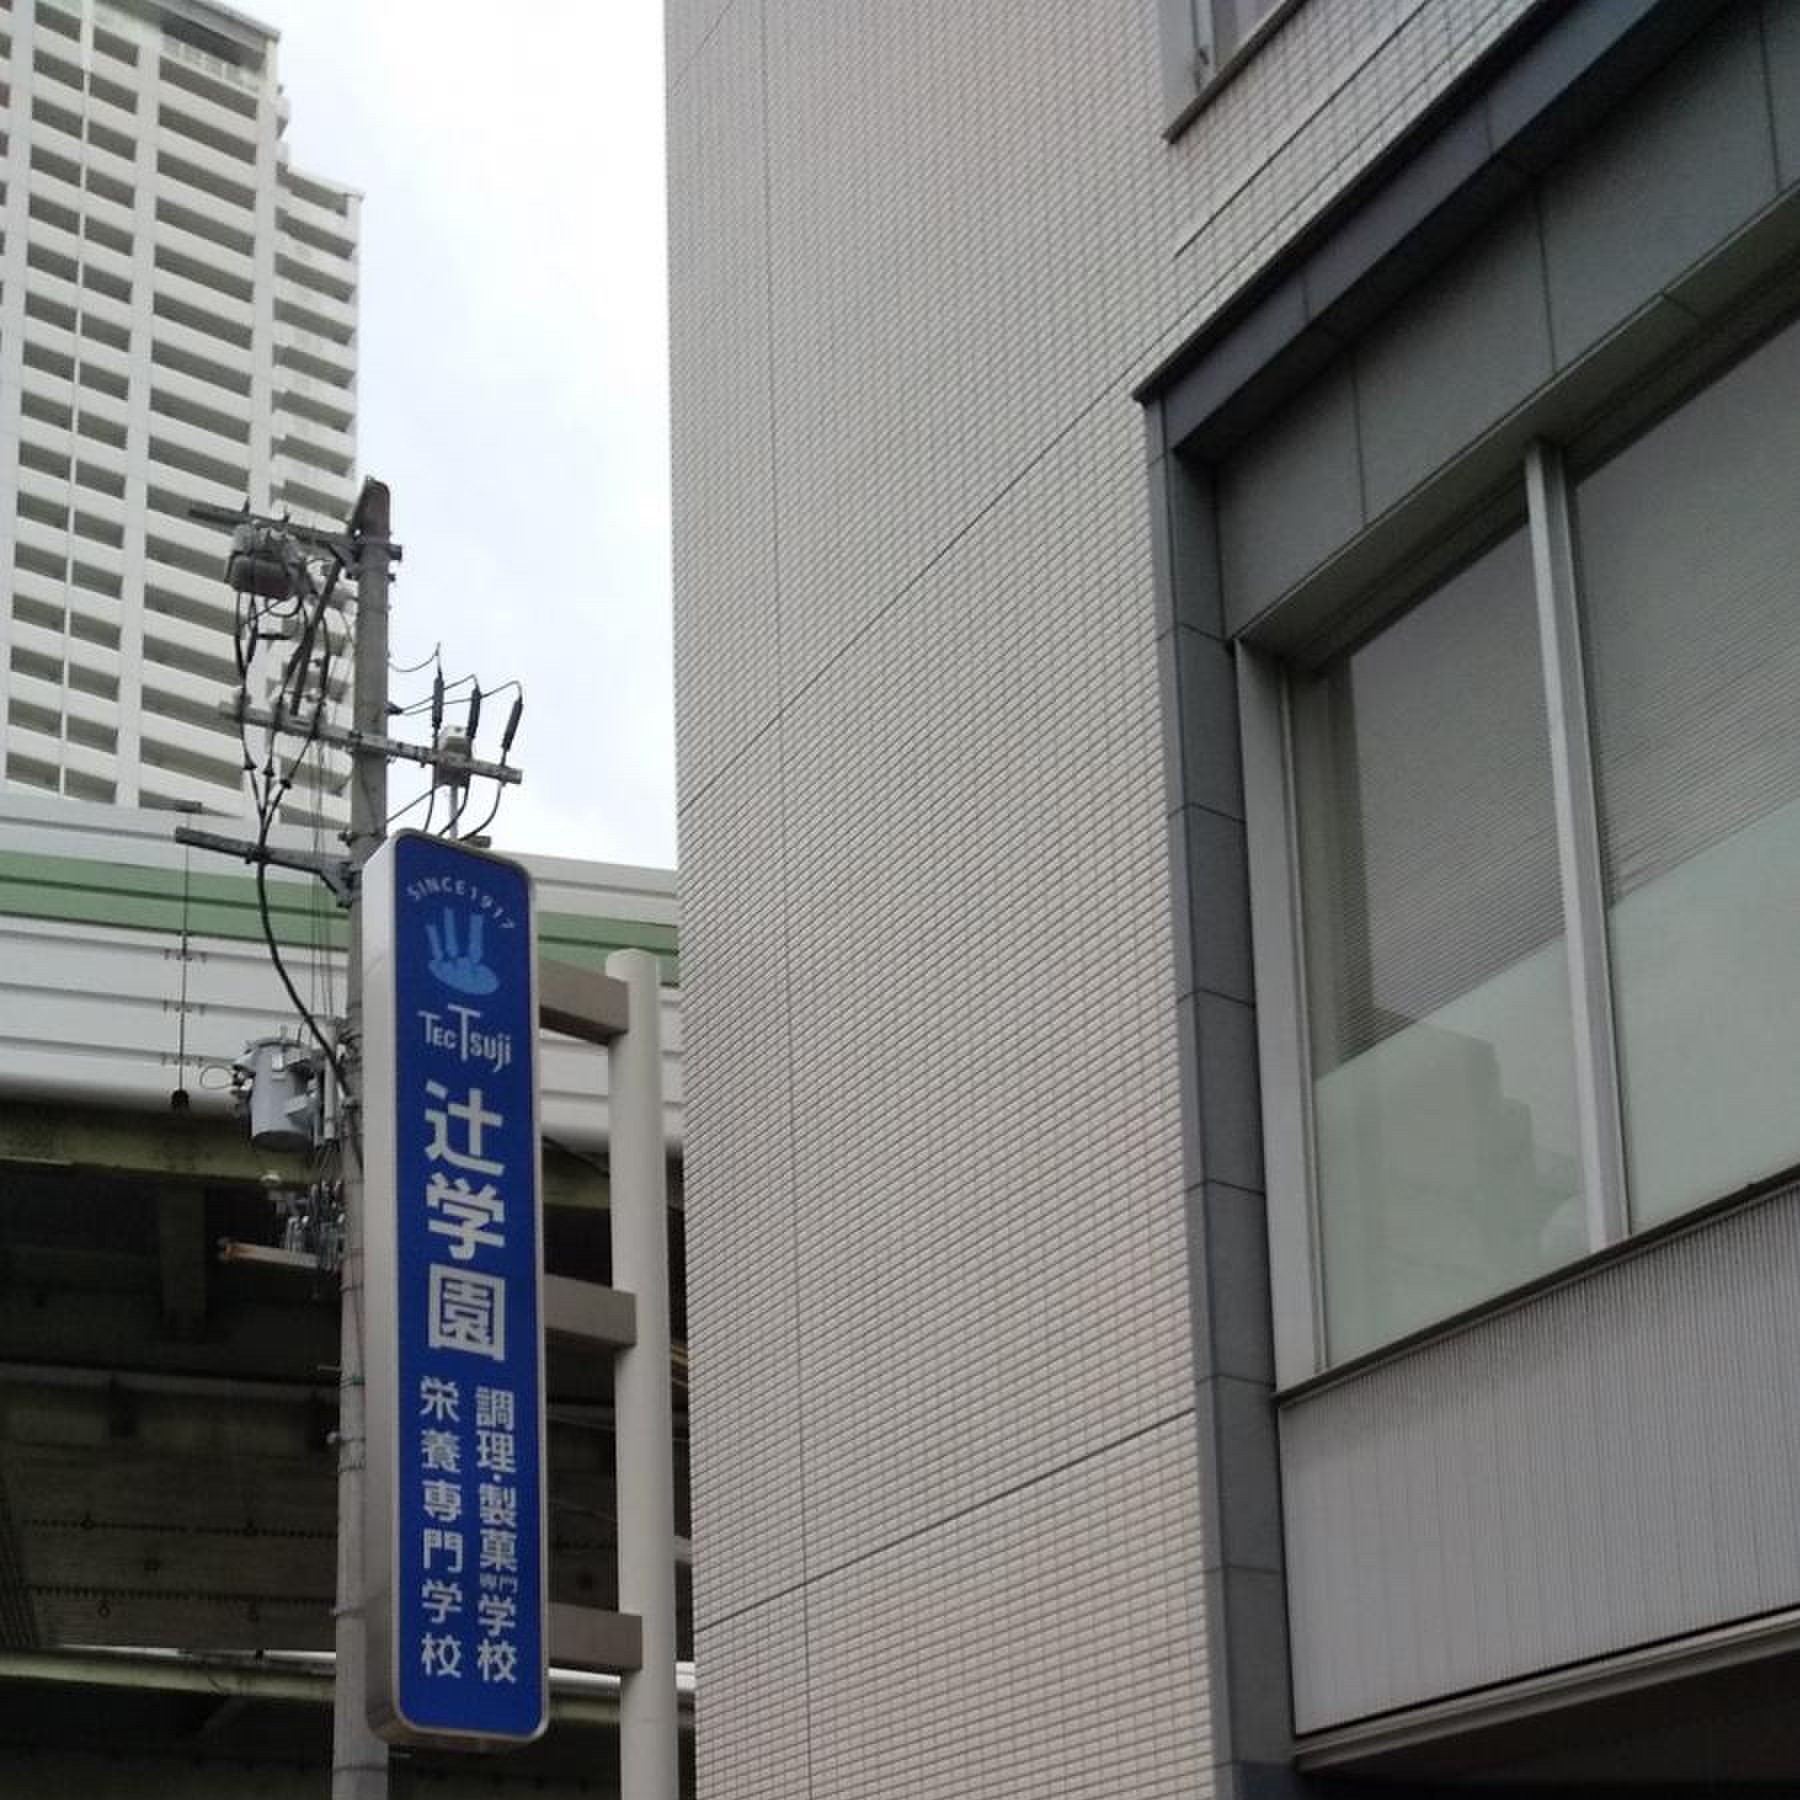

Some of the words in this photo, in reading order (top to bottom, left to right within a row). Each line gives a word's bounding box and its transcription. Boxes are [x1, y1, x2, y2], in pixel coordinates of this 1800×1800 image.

[406, 876, 466, 901] SINCE
[424, 1079, 505, 1362] 辻学園
[420, 1375, 463, 1679] 栄養専門学校
